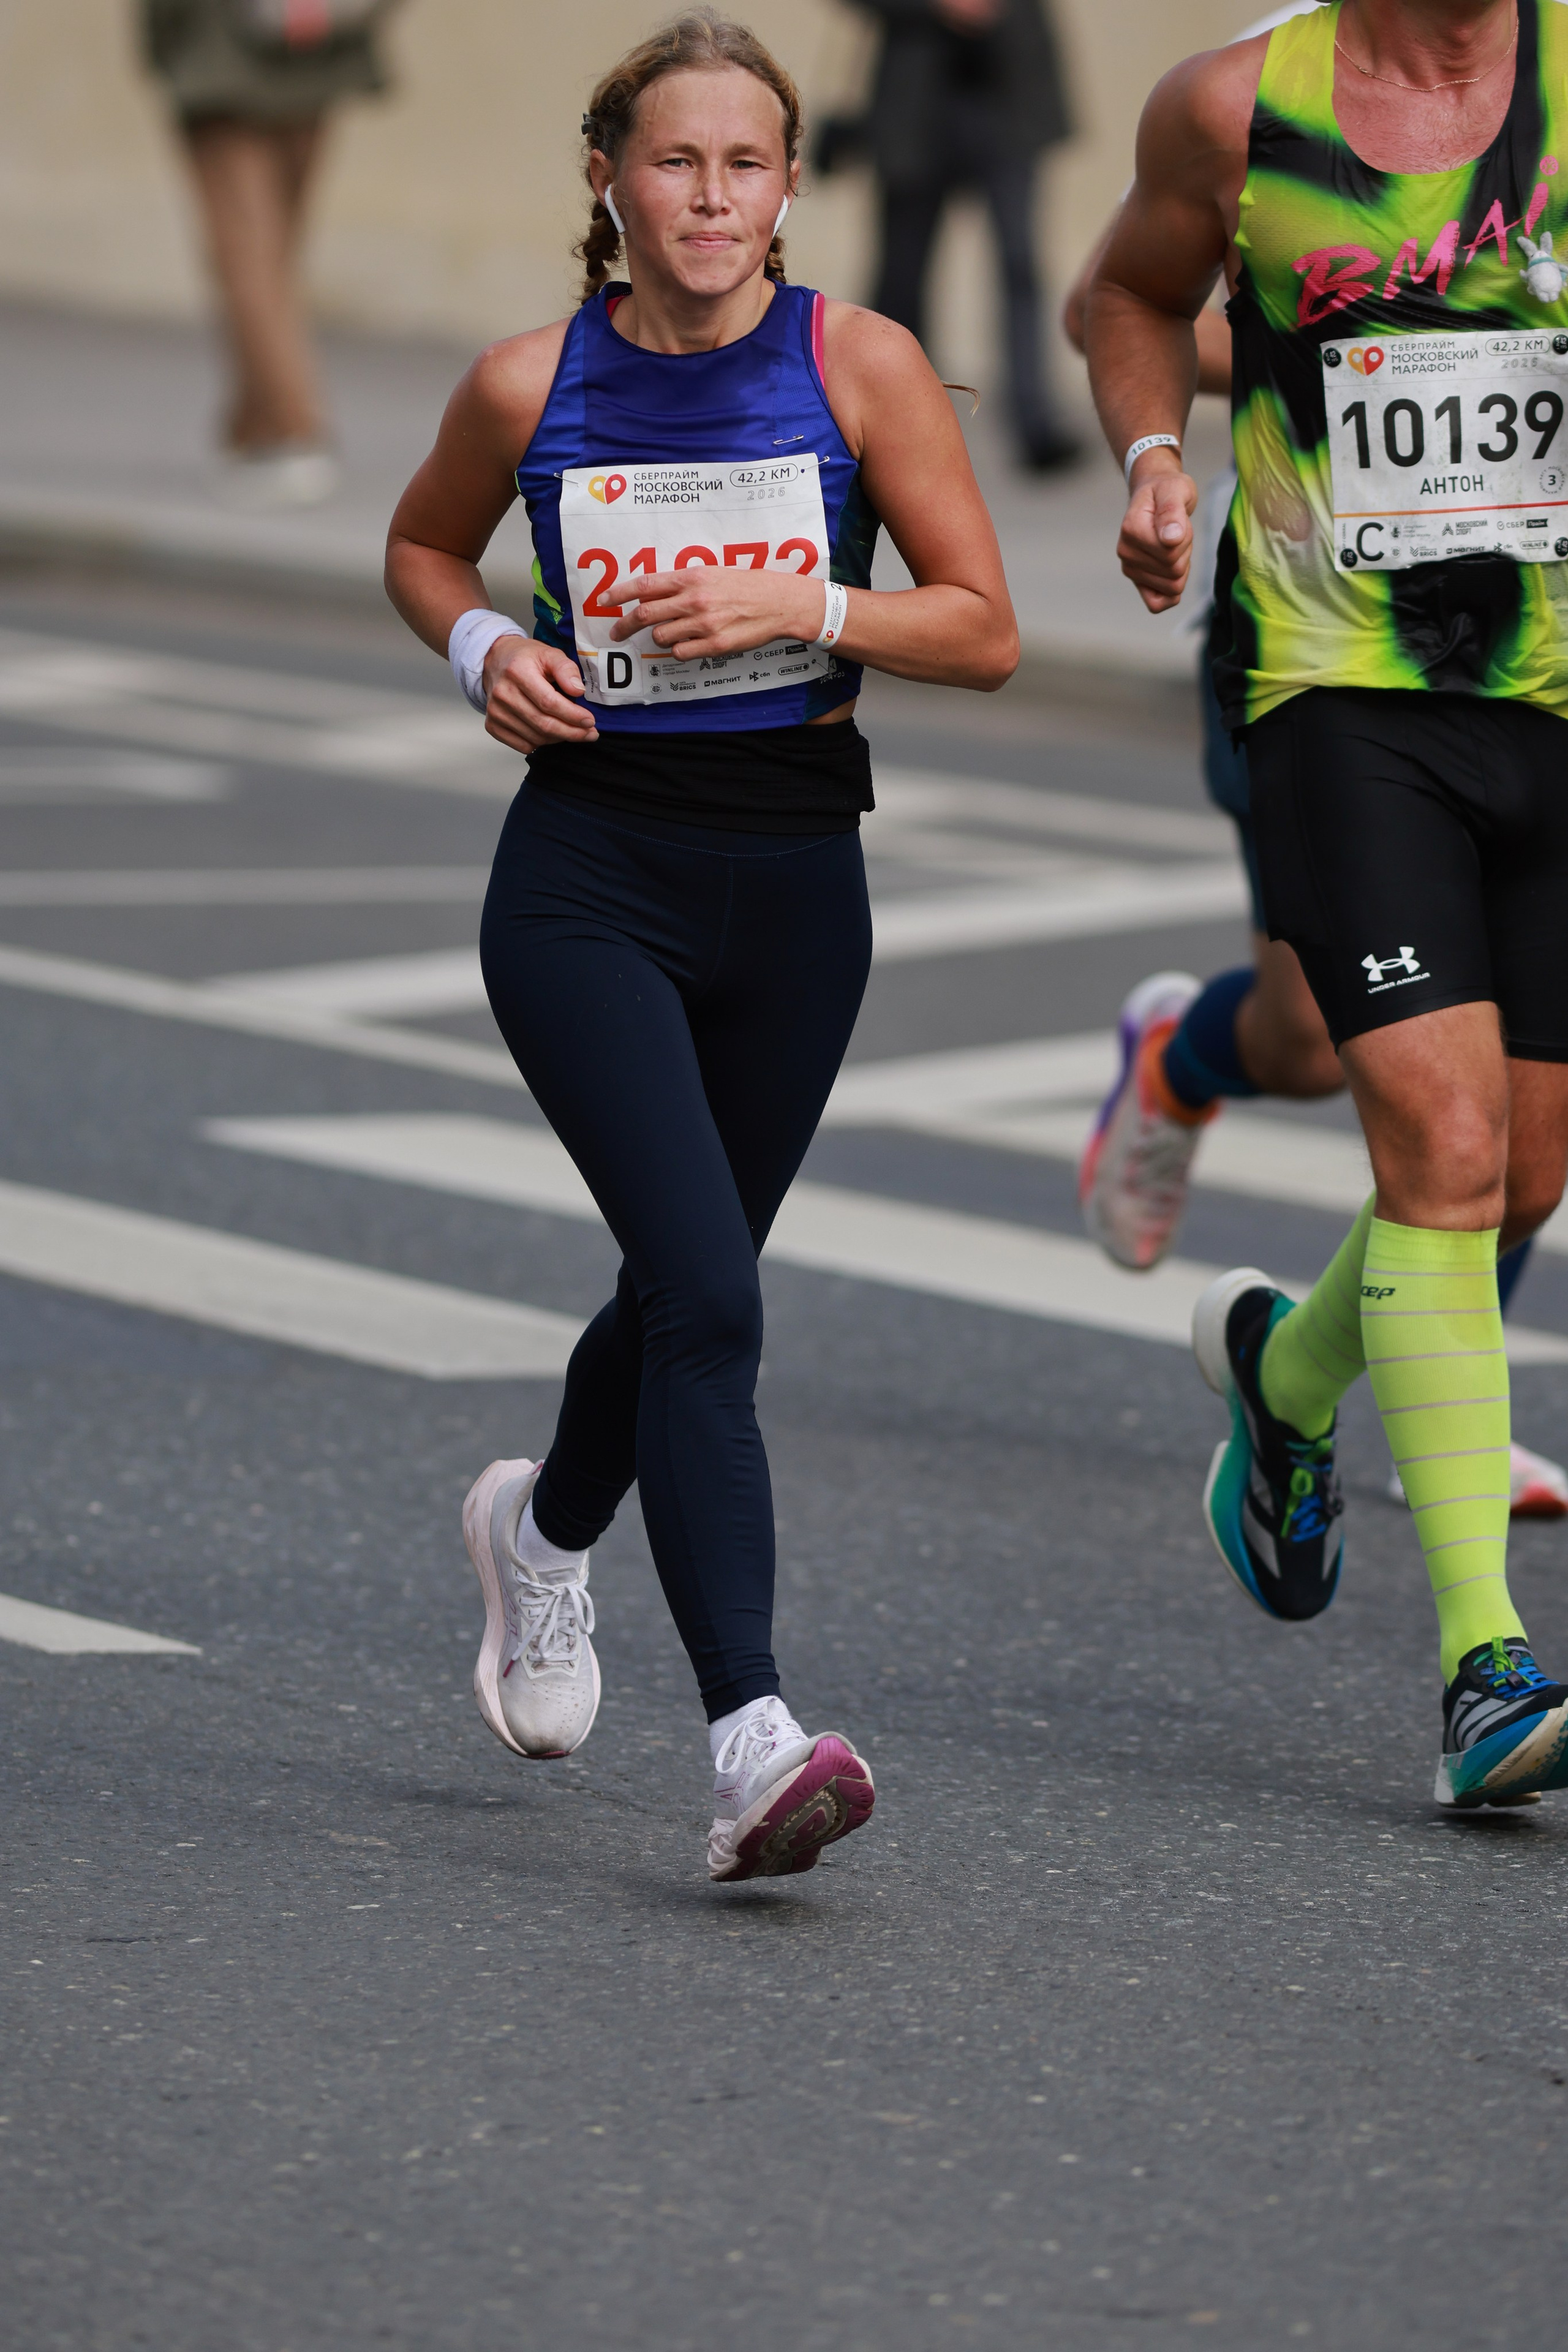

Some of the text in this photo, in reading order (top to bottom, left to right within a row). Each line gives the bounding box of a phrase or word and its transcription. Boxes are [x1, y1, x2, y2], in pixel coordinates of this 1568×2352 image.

[1391, 340, 1455, 352] СБЕРПРАЙМ
[1492, 341, 1520, 353] 42,2
[1525, 340, 1544, 350] КМ
[1392, 348, 1479, 364] МОСКОВСКИЙ
[1392, 362, 1456, 375] МАРАФОН
[1341, 390, 1564, 469] 10139
[1131, 437, 1171, 455] 10139
[634, 470, 699, 480] СБЕРПРАЙМ
[737, 468, 790, 483] 42,2 КМ
[1548, 475, 1556, 486] 3
[634, 478, 723, 492] МОСКОВСКИЙ
[1420, 475, 1484, 496] АНТОН
[634, 493, 700, 504] МАРАФОН
[747, 487, 786, 500] 2026
[1456, 519, 1488, 528] МОСКОВСКИЙ
[1356, 522, 1385, 562] C
[764, 649, 784, 657] СБЕР
[608, 652, 633, 688] D
[711, 676, 741, 685] магнит
[1368, 972, 1431, 993] UNDER ARMOUR
